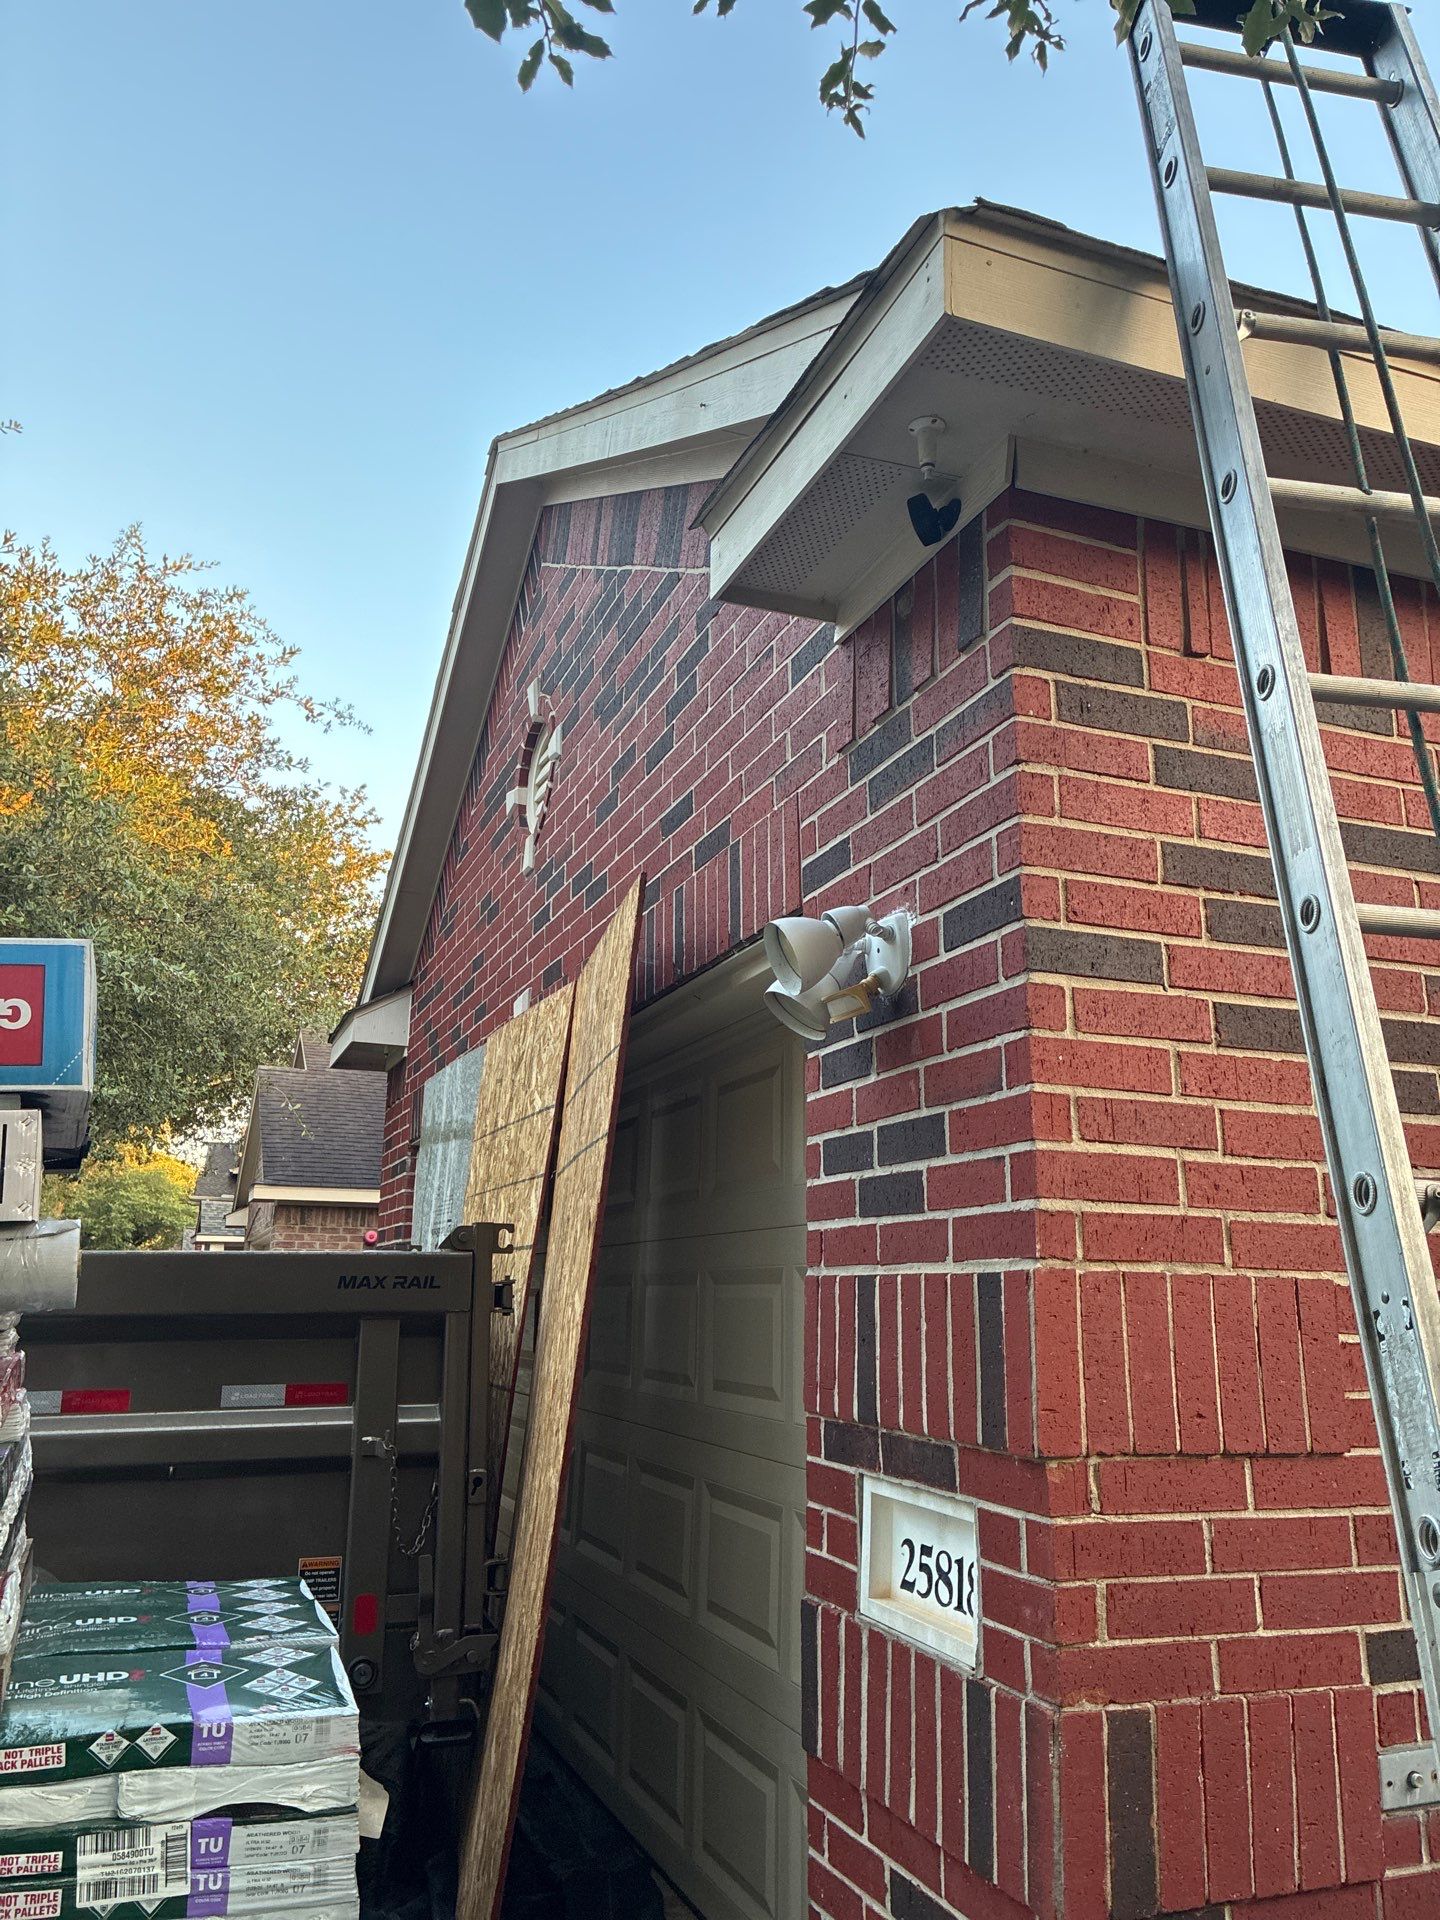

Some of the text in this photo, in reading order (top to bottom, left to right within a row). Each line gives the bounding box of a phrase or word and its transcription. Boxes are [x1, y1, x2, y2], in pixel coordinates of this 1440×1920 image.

[337, 1275, 441, 1289] MAX RAIL
[306, 1560, 340, 1568] WARNING
[14, 1692, 42, 1700] High
[199, 1722, 227, 1738] TU
[4, 1745, 63, 1760] NOT TRIPLE
[0, 1755, 63, 1771] ACK PALLETS
[198, 1837, 223, 1854] TU
[0, 1854, 60, 1866] NOT TRIPLE
[0, 1864, 59, 1875] CK PALLETS
[197, 1873, 223, 1891] TU
[0, 1892, 59, 1907] NOT TRIPLE
[14, 1904, 58, 1919] PALLETS
